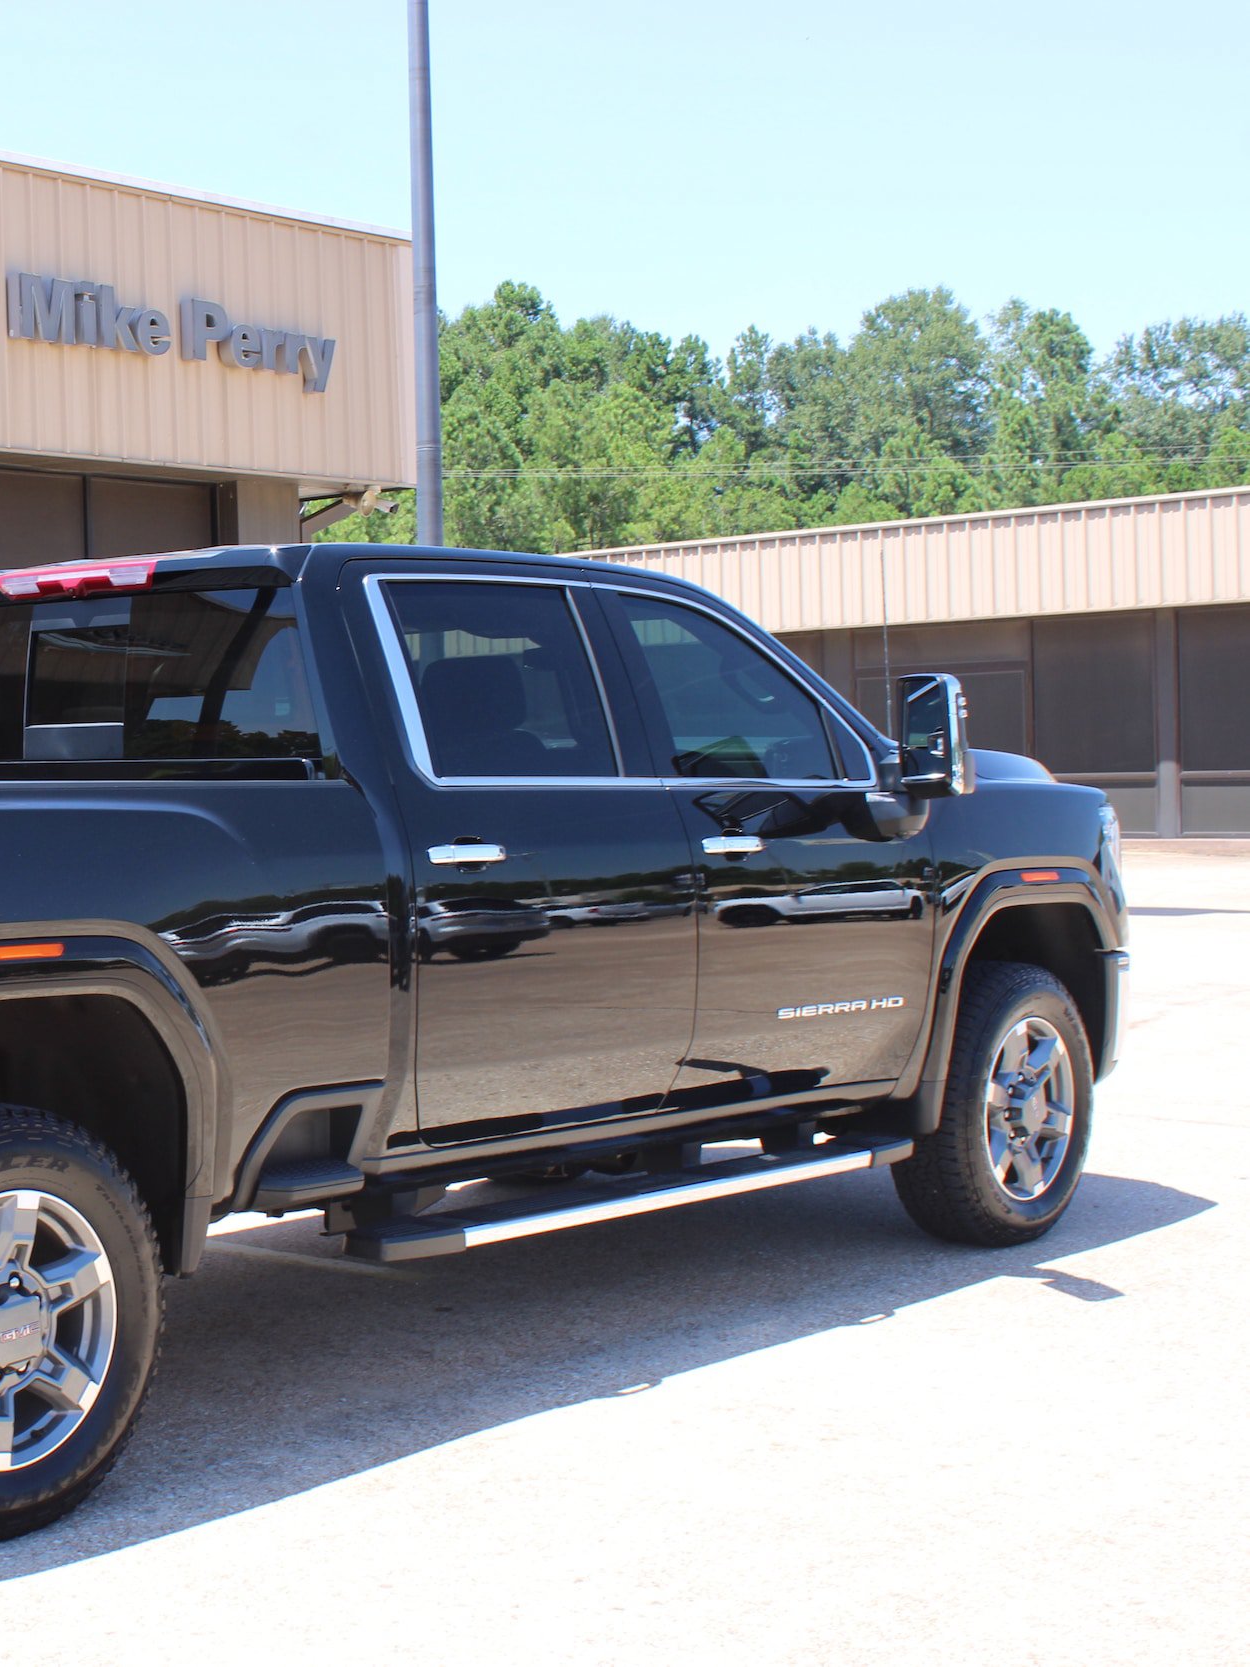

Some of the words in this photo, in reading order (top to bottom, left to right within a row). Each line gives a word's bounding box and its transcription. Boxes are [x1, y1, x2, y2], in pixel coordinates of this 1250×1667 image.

[6, 272, 171, 356] Mike
[180, 298, 335, 393] Perry
[777, 999, 868, 1020] SIERRA
[870, 996, 905, 1010] HD
[0, 1320, 40, 1343] GMC
